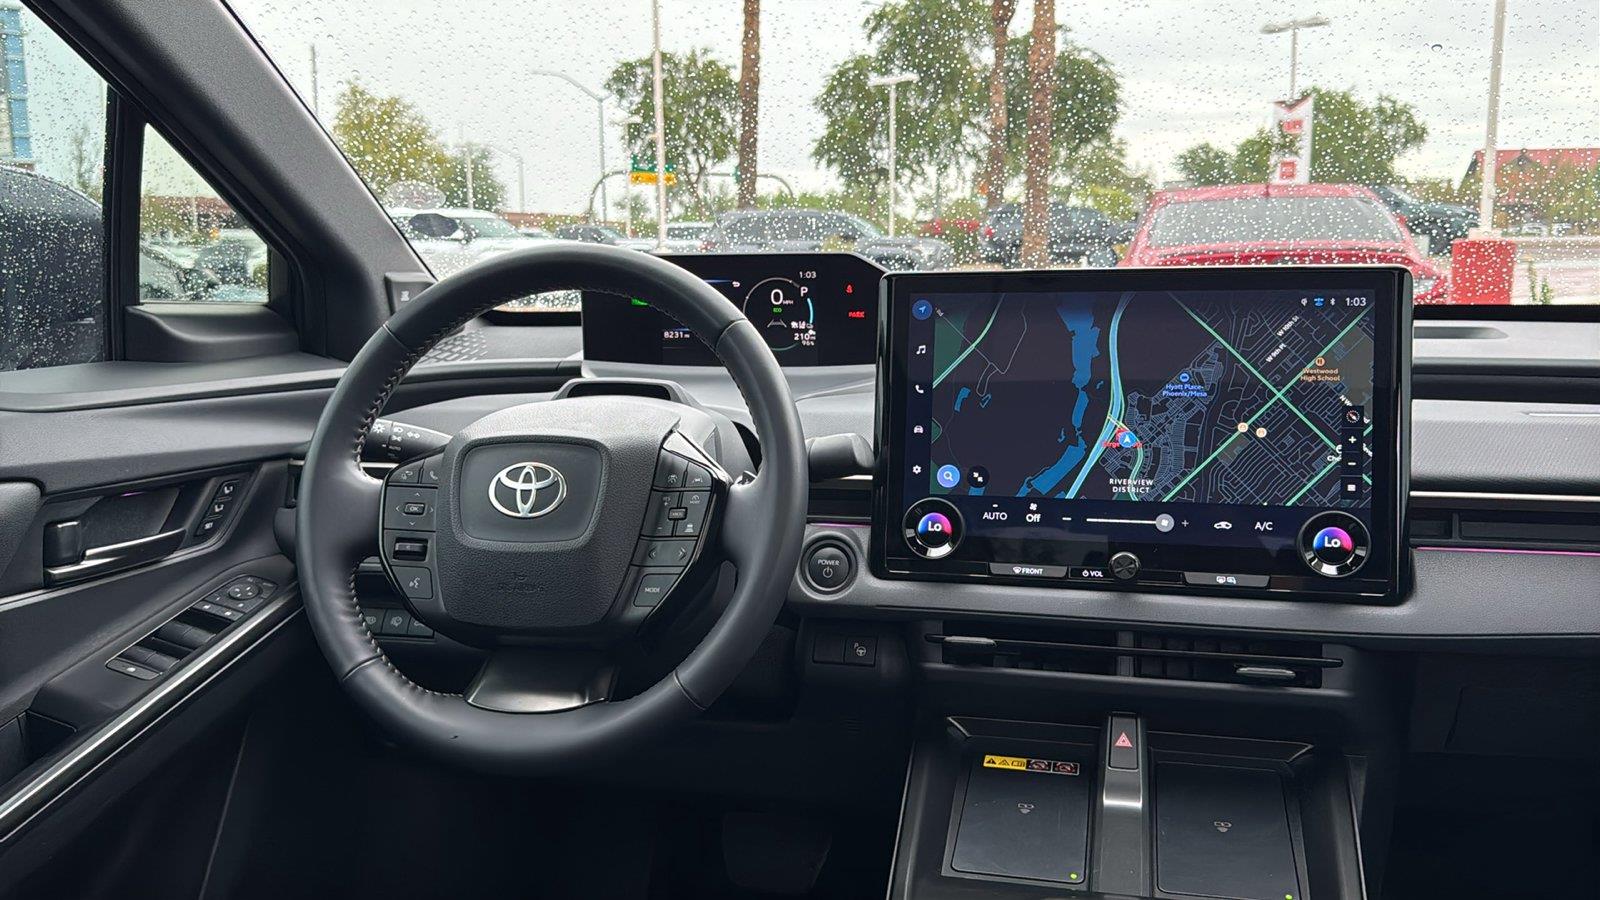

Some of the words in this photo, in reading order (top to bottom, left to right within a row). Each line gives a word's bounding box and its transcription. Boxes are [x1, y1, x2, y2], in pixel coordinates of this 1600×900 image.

[800, 286, 808, 297] P
[770, 288, 784, 305] 0
[1345, 297, 1366, 306] 1:03
[982, 512, 1008, 521] AUTO
[1026, 513, 1041, 522] Off
[928, 522, 942, 532] Lo
[1254, 522, 1273, 530] A/C
[1324, 536, 1340, 548] Lo
[1022, 567, 1044, 575] FRONT
